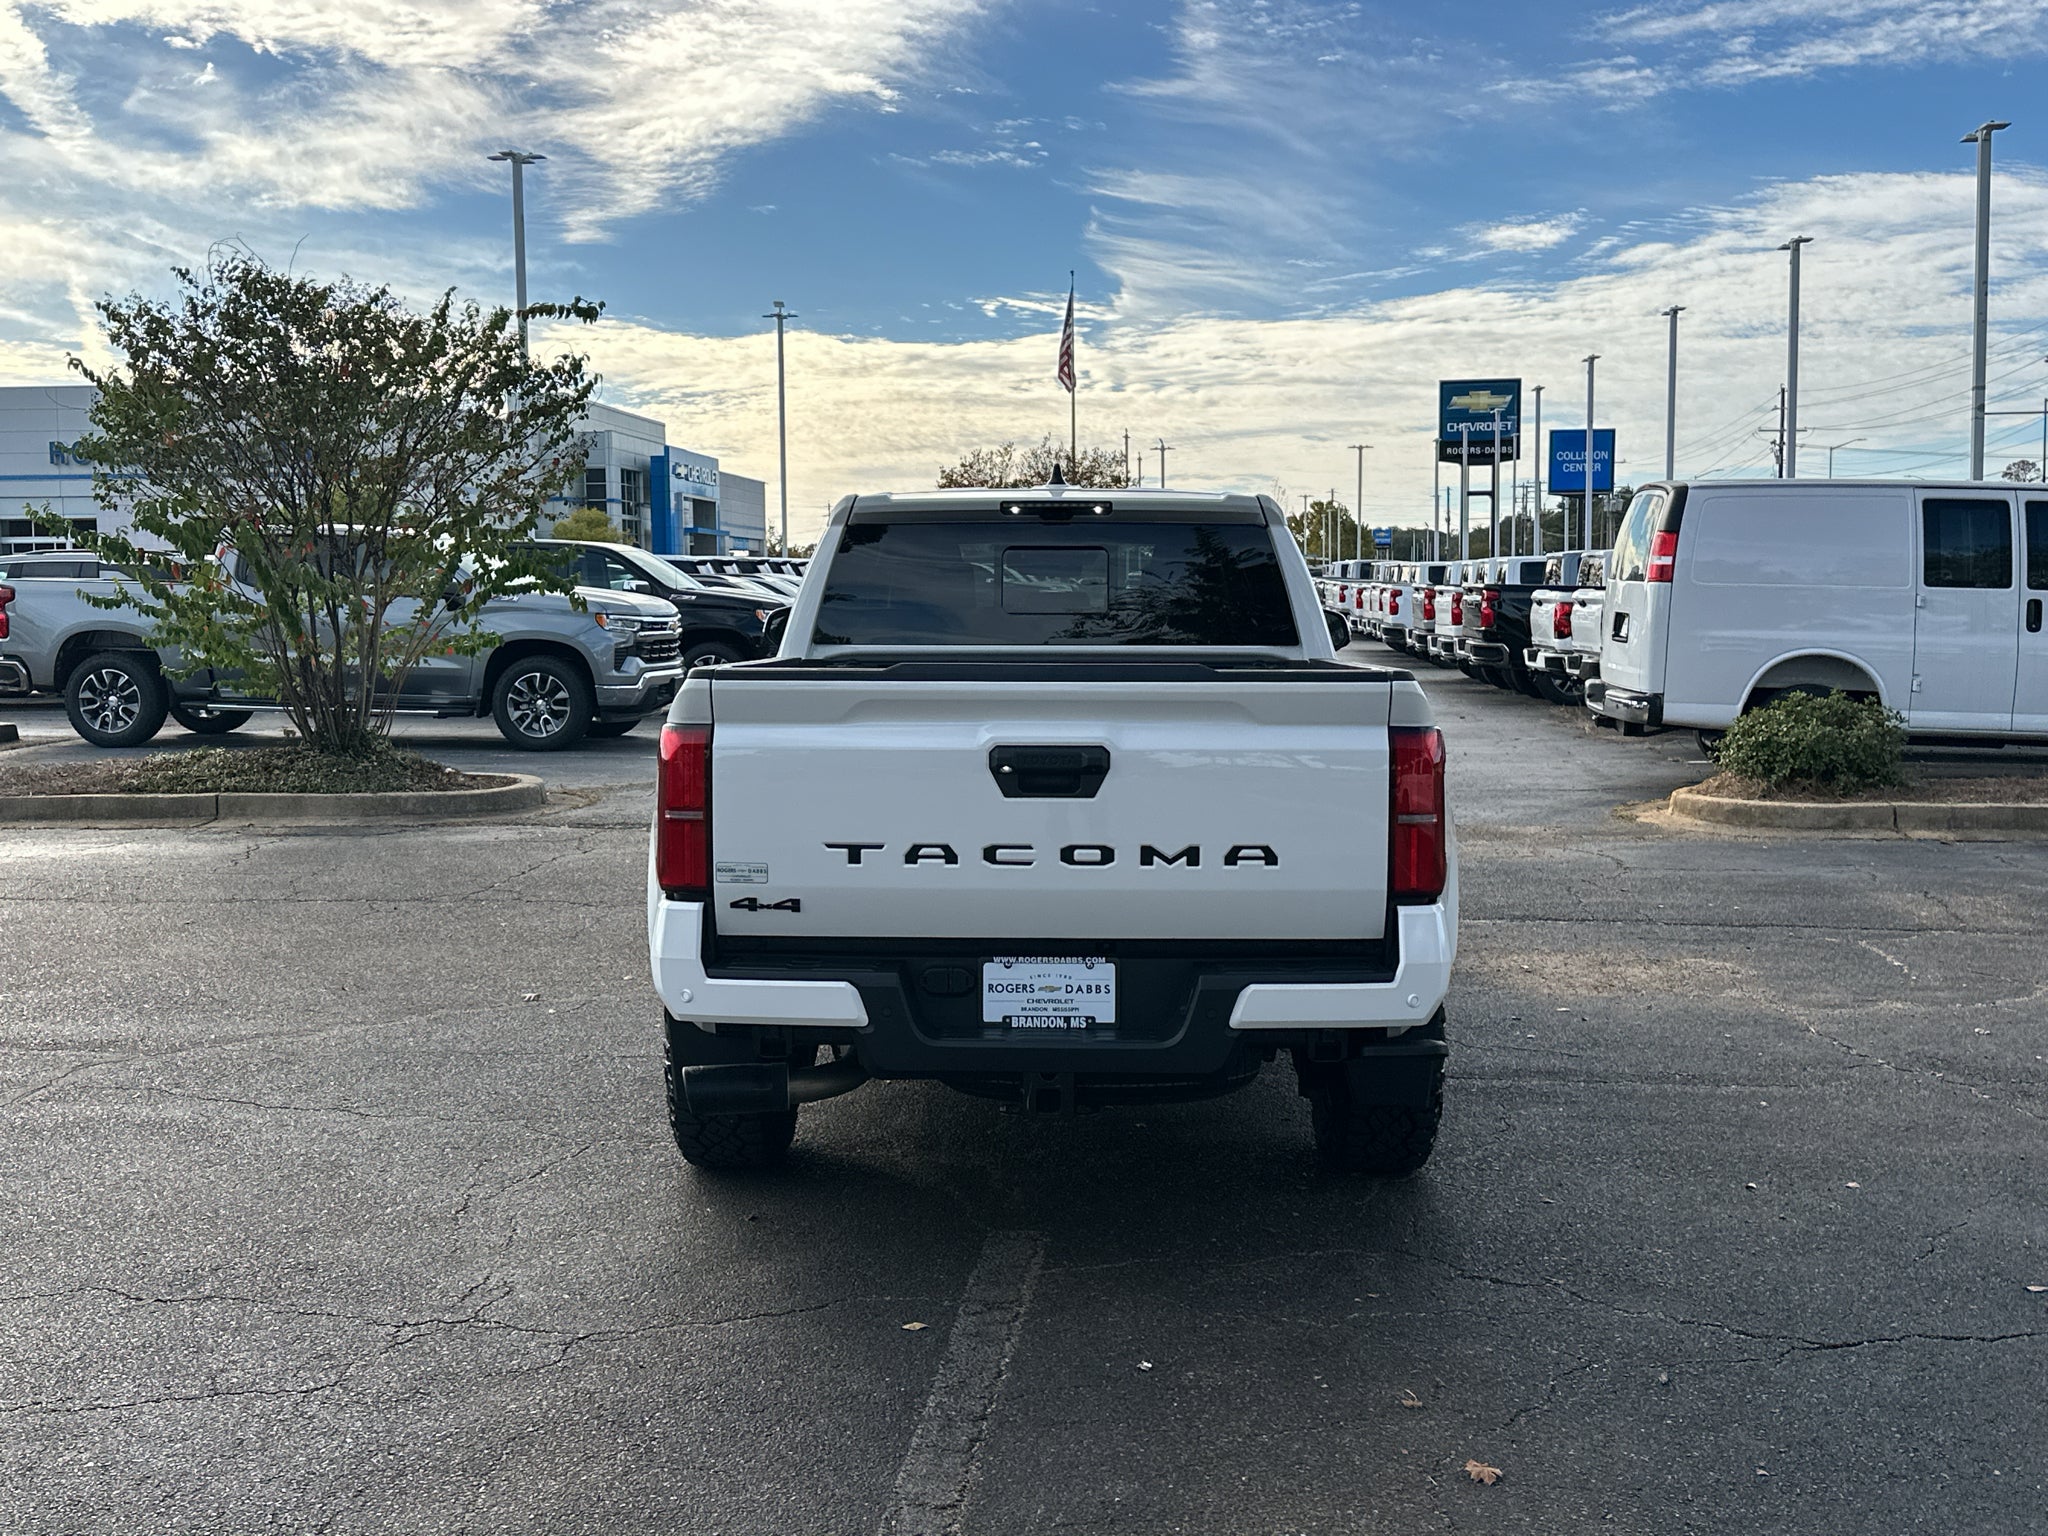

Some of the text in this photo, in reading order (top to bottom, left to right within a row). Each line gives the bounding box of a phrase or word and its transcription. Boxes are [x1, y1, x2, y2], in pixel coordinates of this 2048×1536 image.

[1556, 451, 1609, 461] COLLION
[1562, 463, 1602, 472] CENR
[823, 843, 1279, 867] TACOMA
[987, 983, 1111, 994] ROGERS DABBS
[1011, 1016, 1087, 1029] BRANDON, MS
